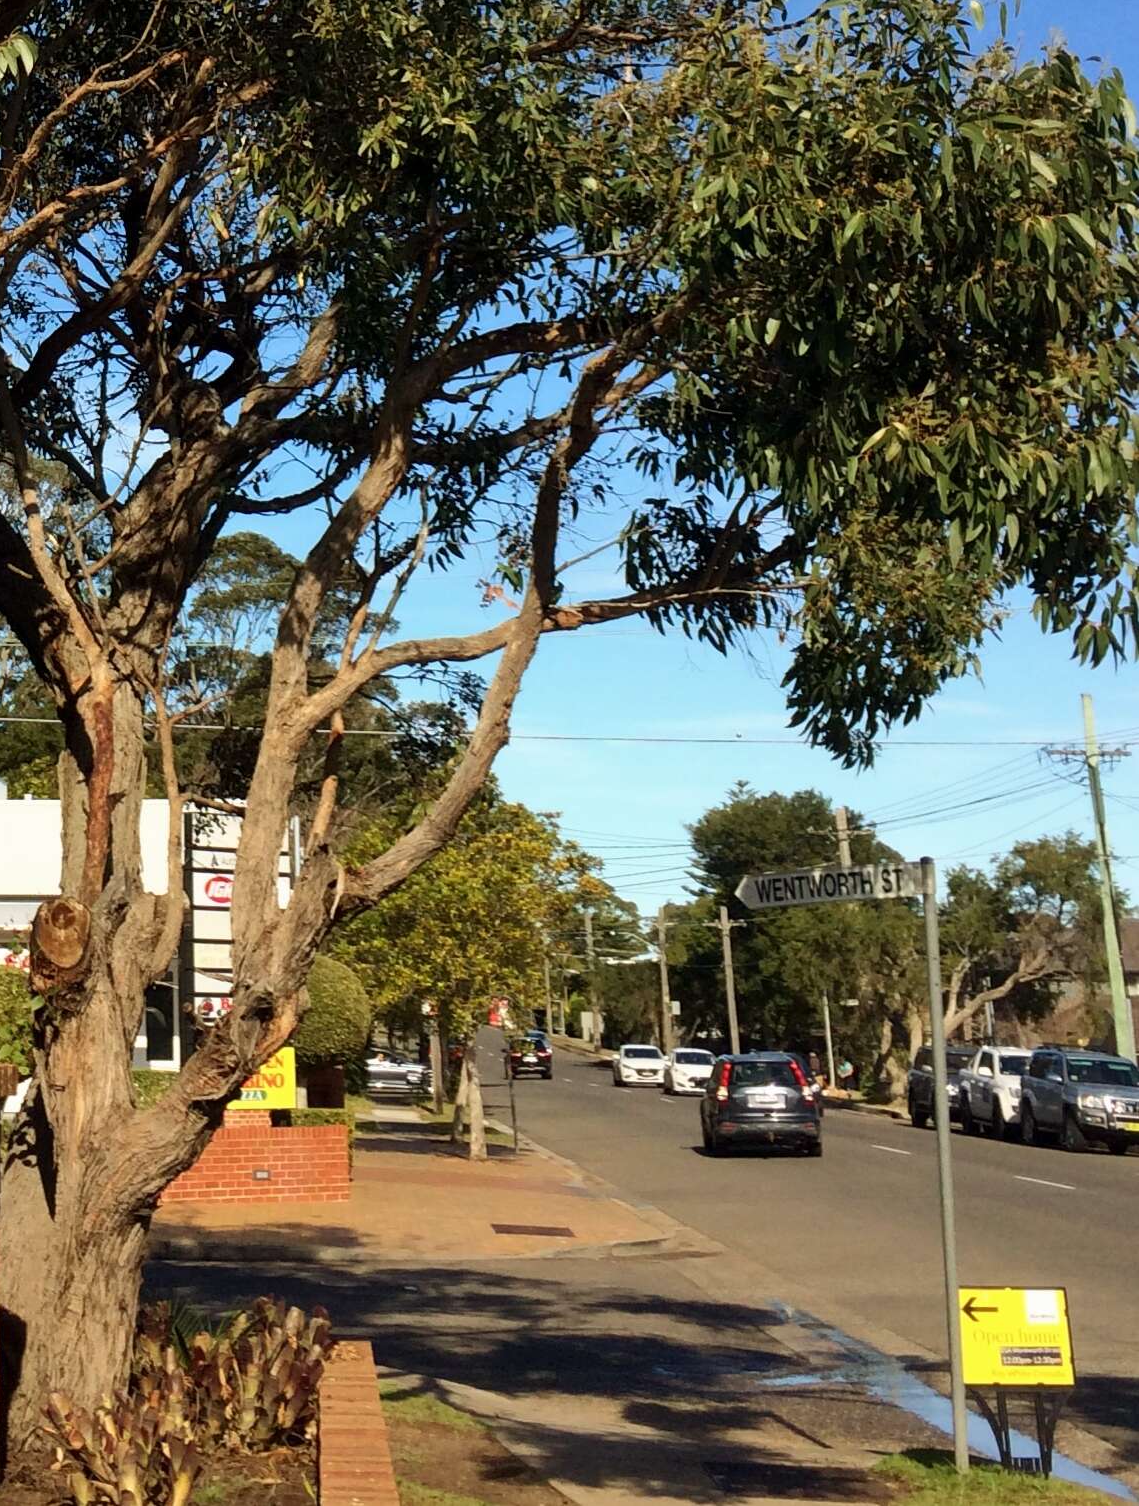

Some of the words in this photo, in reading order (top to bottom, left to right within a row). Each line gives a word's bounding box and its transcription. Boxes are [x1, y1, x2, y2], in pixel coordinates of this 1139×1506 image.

[755, 870, 873, 903] WENTWORTH
[881, 868, 903, 894] ST
[973, 1328, 1014, 1346] Open
[1018, 1328, 1060, 1343] home
